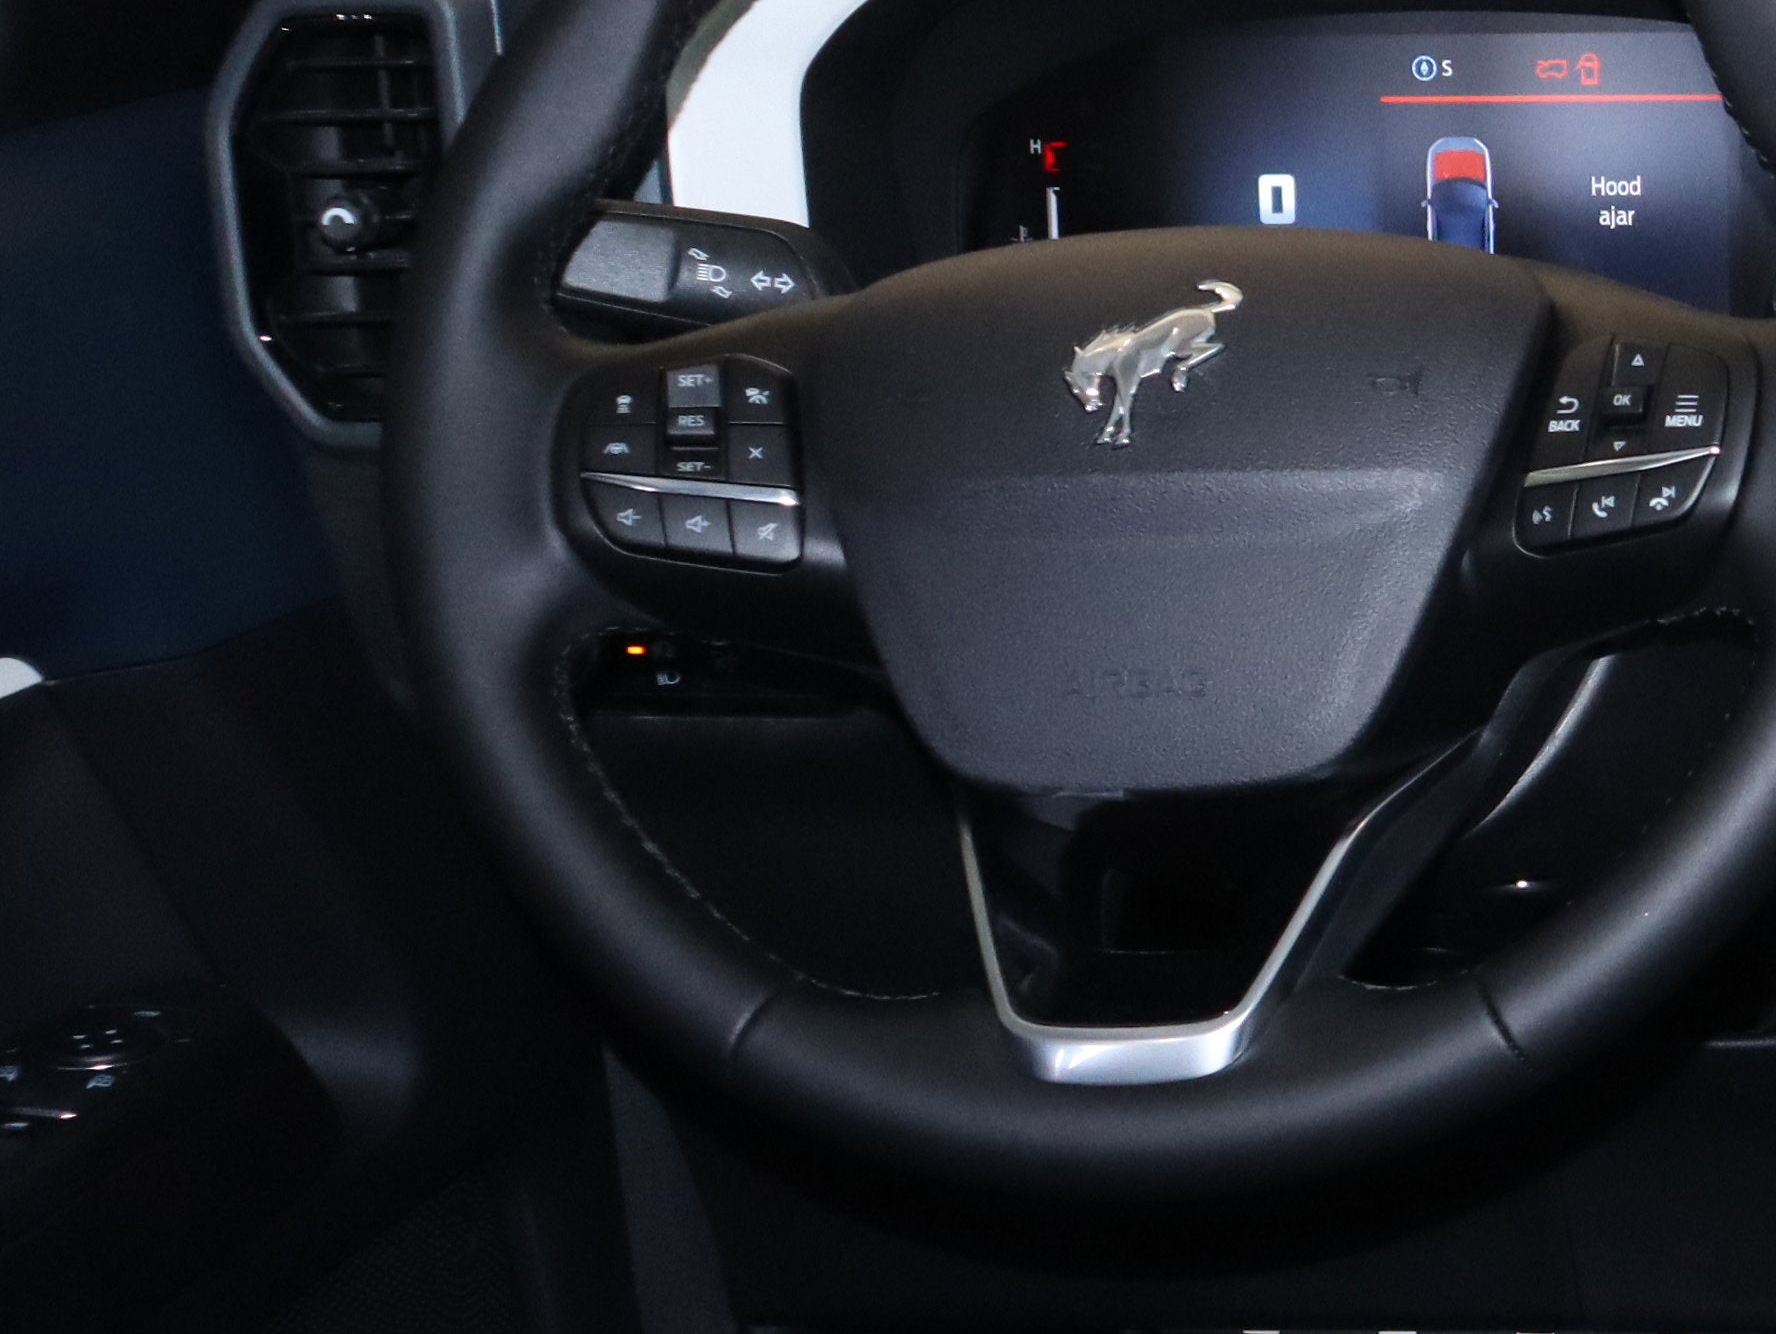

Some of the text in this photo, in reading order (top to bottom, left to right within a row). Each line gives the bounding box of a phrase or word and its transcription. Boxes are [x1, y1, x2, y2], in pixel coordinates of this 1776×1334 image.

[1441, 59, 1453, 77] S
[1590, 175, 1642, 197] Hood
[1599, 205, 1636, 229] ajar
[1612, 393, 1633, 407] OK
[677, 415, 705, 427] RES
[1547, 419, 1581, 433] BACK
[1664, 415, 1703, 428] MENU
